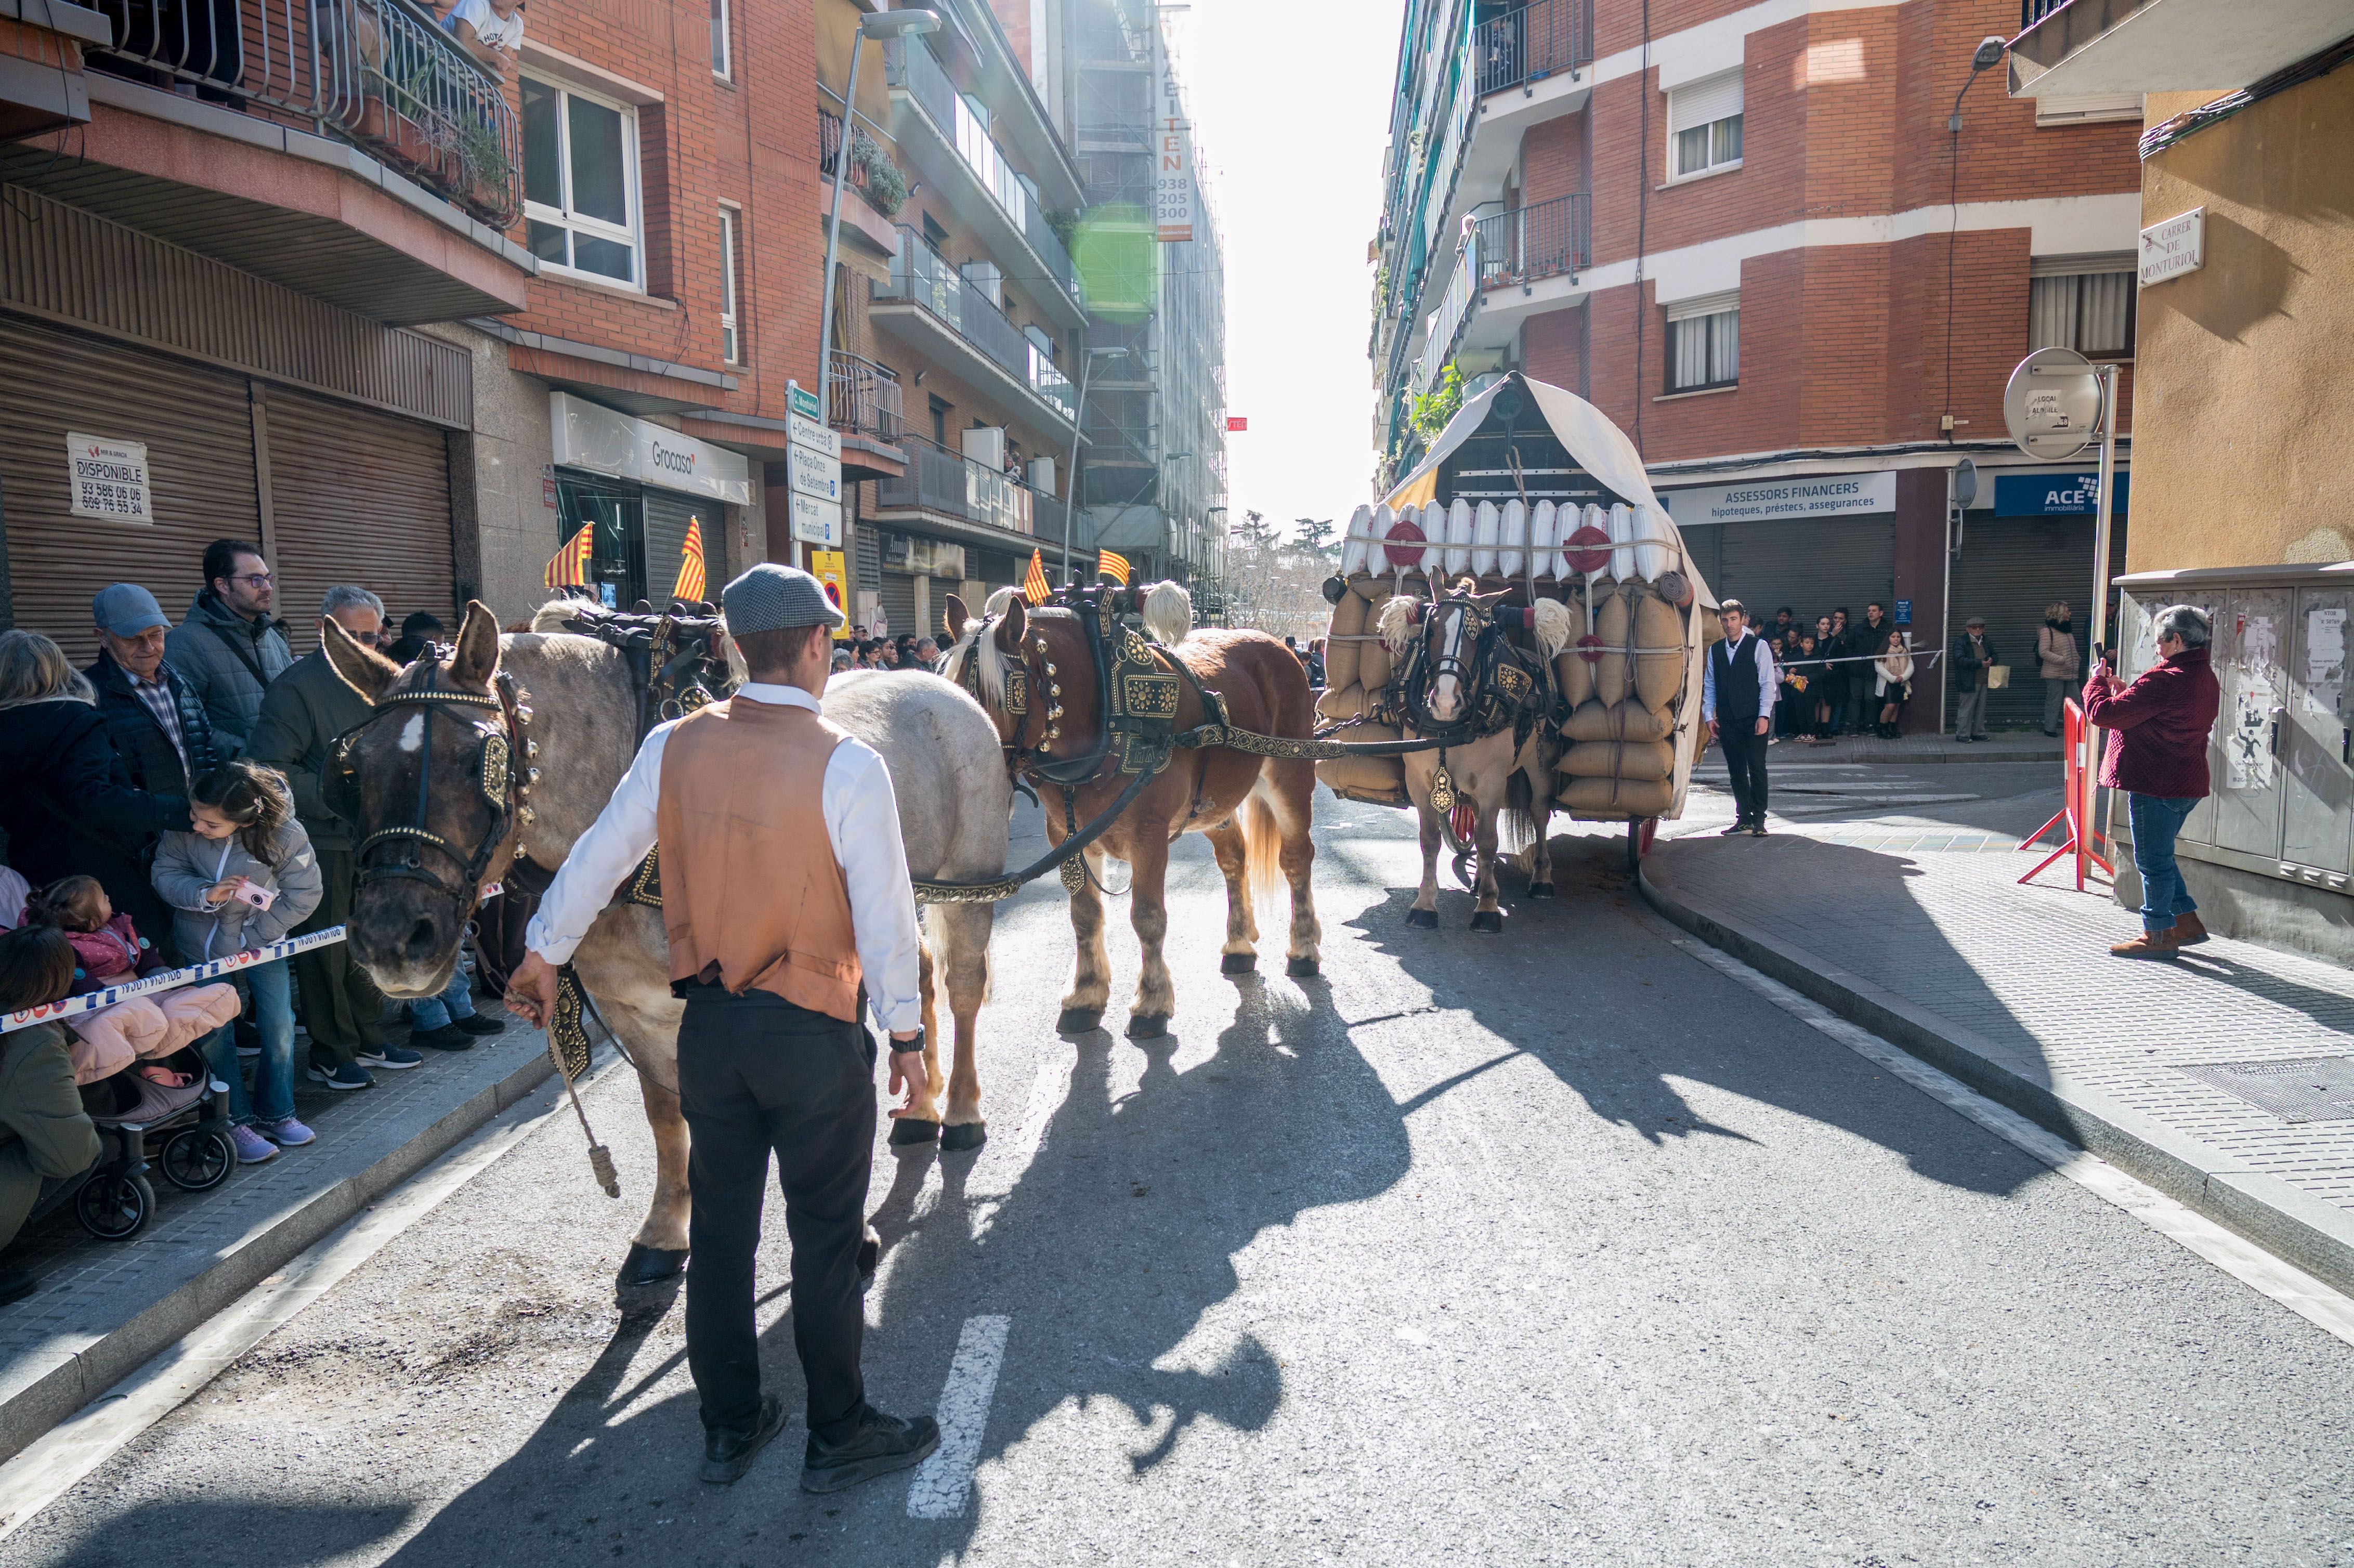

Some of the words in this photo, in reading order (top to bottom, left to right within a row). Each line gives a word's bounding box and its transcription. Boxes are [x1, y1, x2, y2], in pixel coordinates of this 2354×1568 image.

[1158, 179, 1187, 190] 938
[1158, 193, 1187, 204] 205
[1158, 208, 1187, 218] 300
[2162, 220, 2190, 240] CARRER
[2167, 239, 2180, 254] DE
[2141, 250, 2196, 279] MONTURIOL
[794, 393, 799, 405] C.
[799, 396, 817, 413] Monturiol
[798, 422, 815, 441] Centre
[652, 441, 691, 475] Grocasa
[799, 450, 813, 472] Plaça
[814, 456, 826, 473] Onze
[77, 461, 142, 482] DISPONIBLE
[82, 481, 94, 494] 93
[96, 483, 113, 497] 586
[116, 486, 127, 499] 06
[130, 488, 141, 501] 06
[800, 472, 806, 486] de
[807, 474, 829, 493] Setembre
[1725, 488, 1788, 503] ASSESSORS
[1792, 482, 1859, 498] FINANCERS
[2045, 490, 2085, 504] ACE
[117, 500, 128, 513] 55
[131, 502, 142, 515] 34
[801, 499, 818, 516] Mercat
[1711, 506, 1762, 518] hipoteques,
[1766, 503, 1806, 515] préstecs,
[1809, 498, 1874, 511] assegurances
[802, 521, 825, 539] municipal
